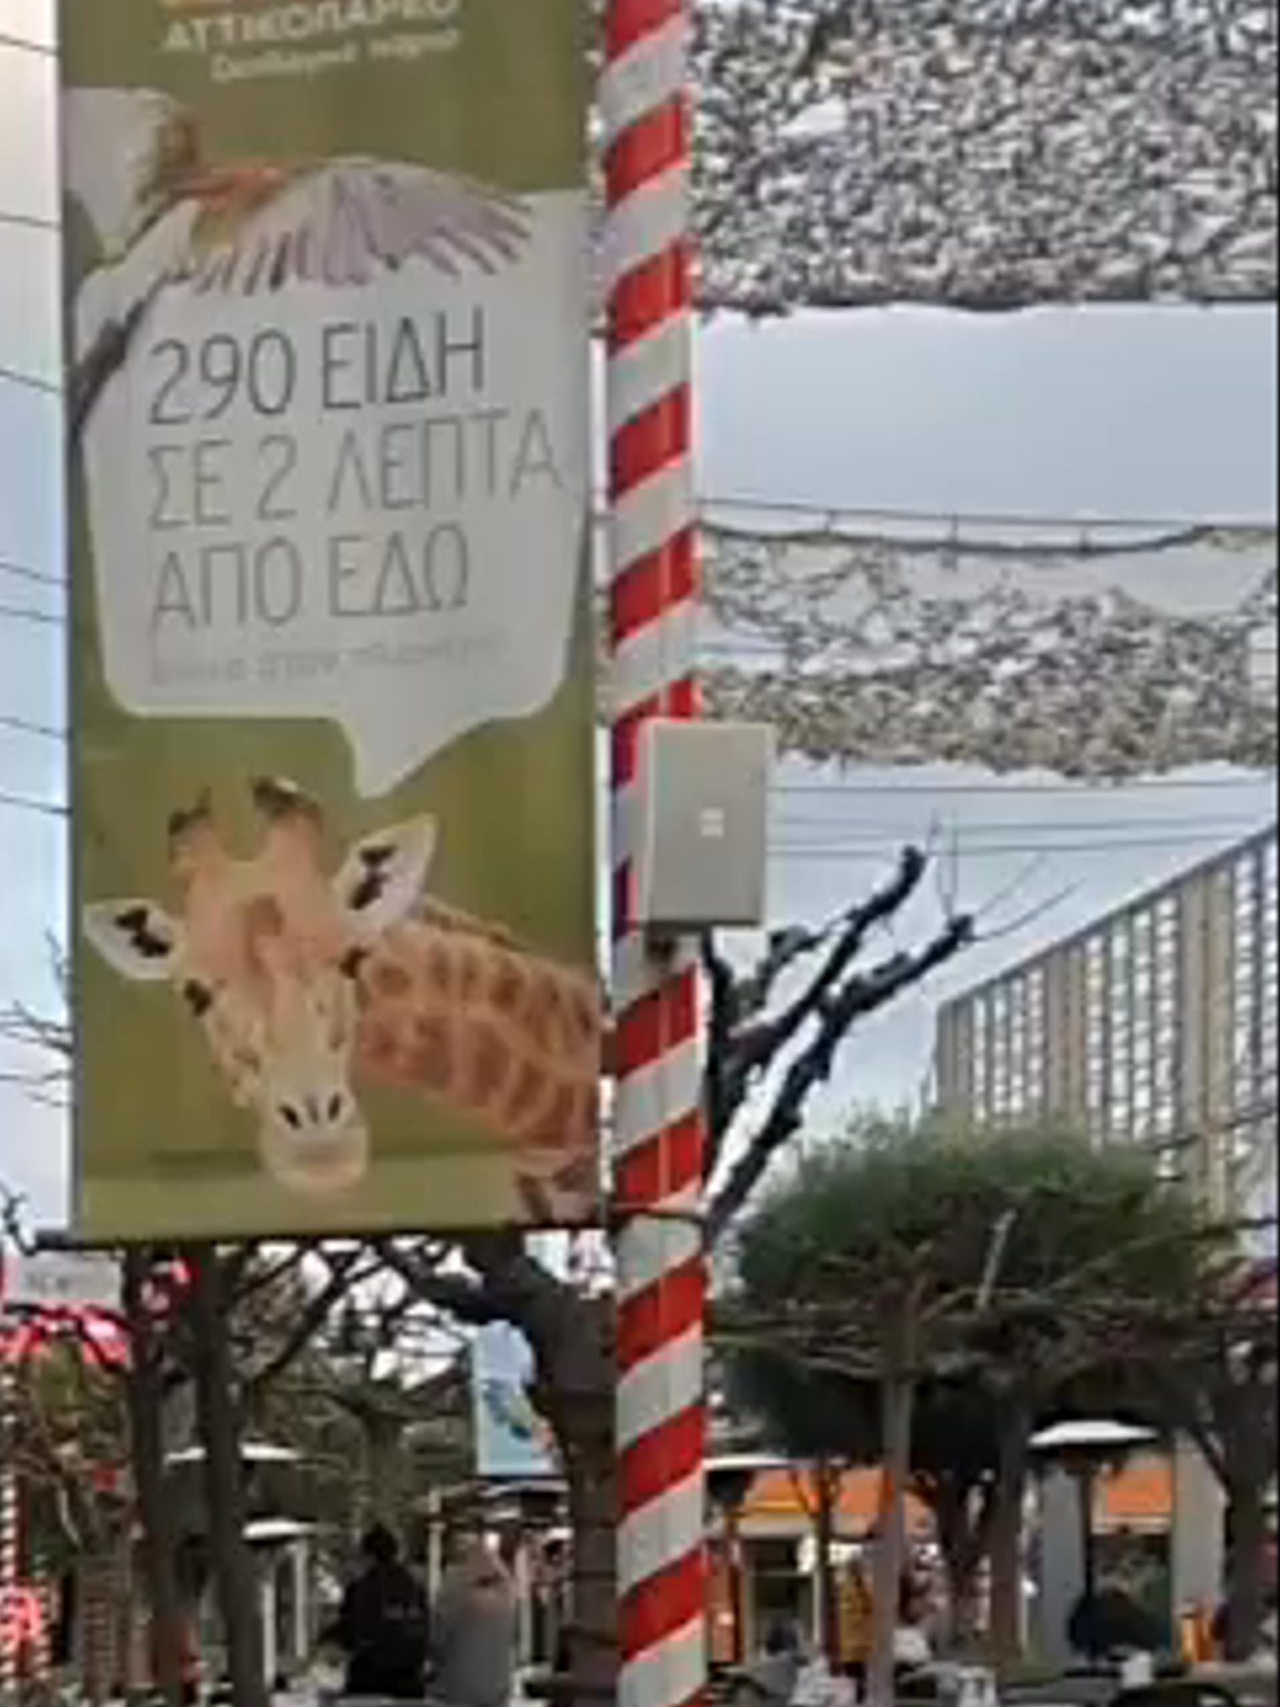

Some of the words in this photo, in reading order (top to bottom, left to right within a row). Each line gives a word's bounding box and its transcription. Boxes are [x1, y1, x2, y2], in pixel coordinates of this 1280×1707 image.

[148, 328, 297, 425] 290
[320, 305, 485, 411] ΕΙΔΗ
[146, 440, 233, 530] ΣΕ
[257, 433, 298, 521] 2
[326, 407, 564, 513] ΛΕΠΤΑ
[150, 536, 303, 631] ΑΠΟ
[328, 520, 470, 619] ΕΔΩ
